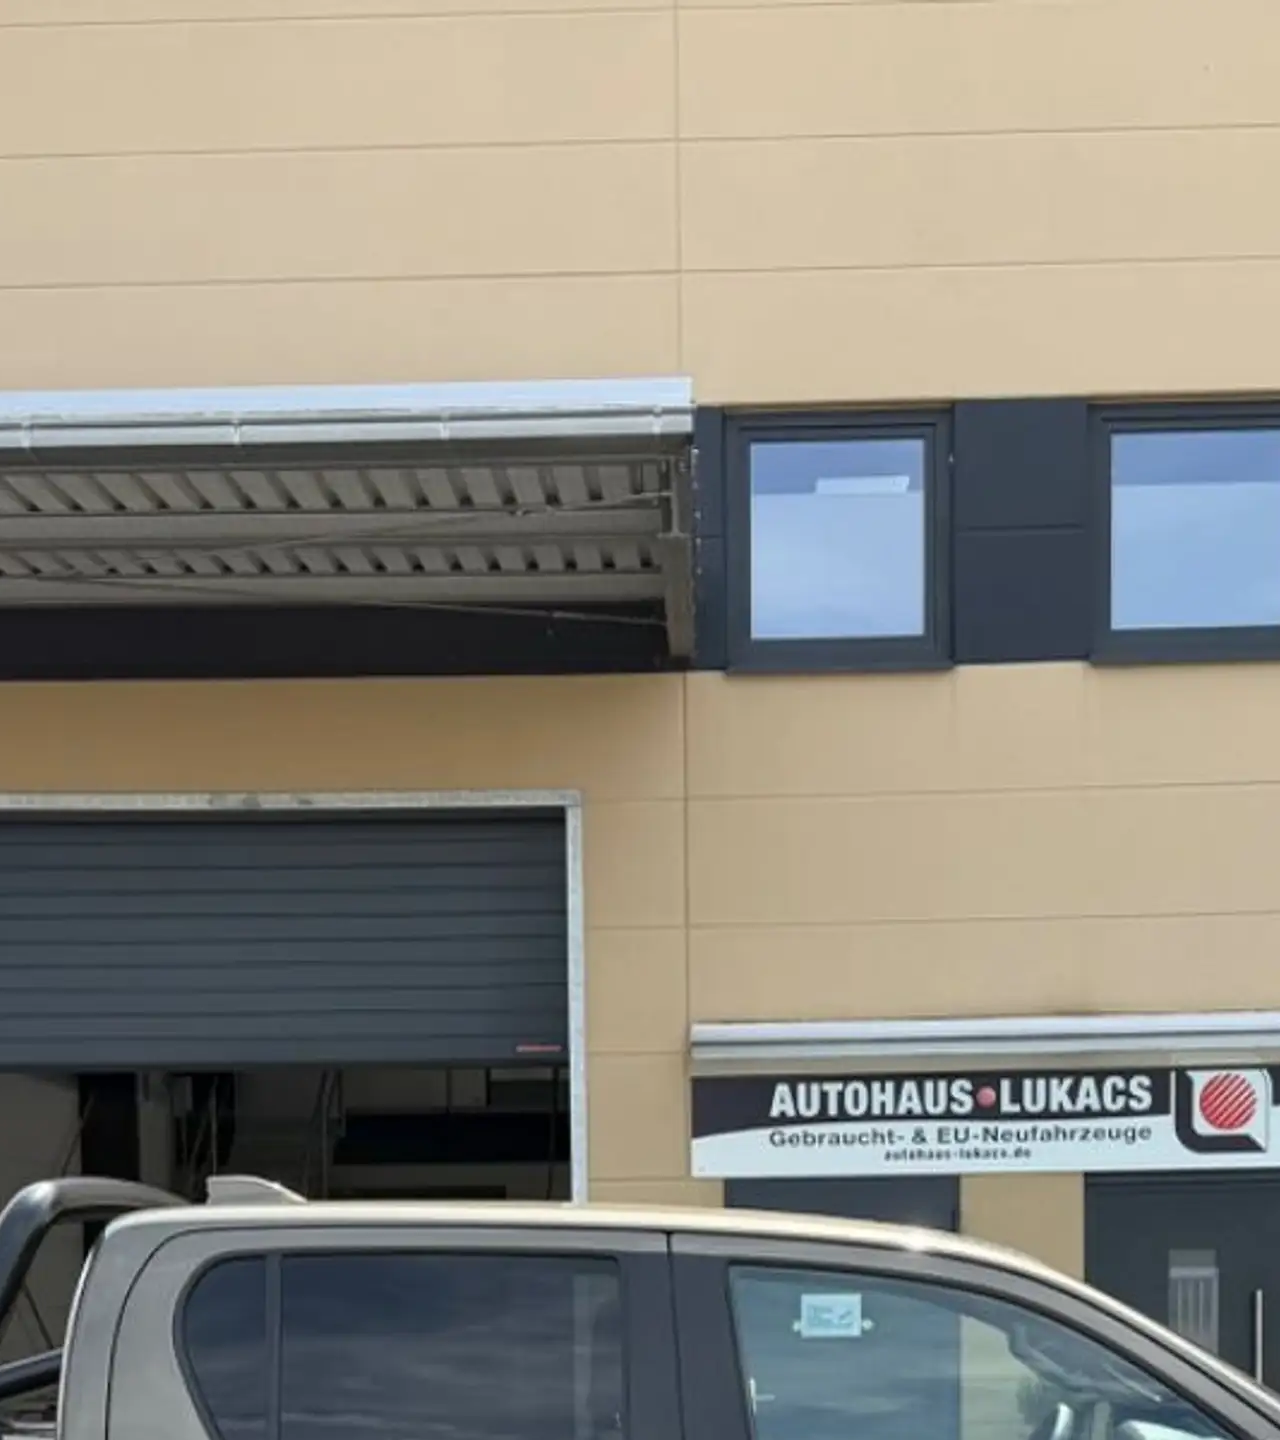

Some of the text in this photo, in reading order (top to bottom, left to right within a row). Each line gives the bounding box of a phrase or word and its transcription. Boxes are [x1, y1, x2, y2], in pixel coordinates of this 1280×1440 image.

[769, 1074, 1153, 1118] AUTOHAUS LUKACS
[770, 1124, 1152, 1148] Gebraucht- & EU-Neufahrzeuge
